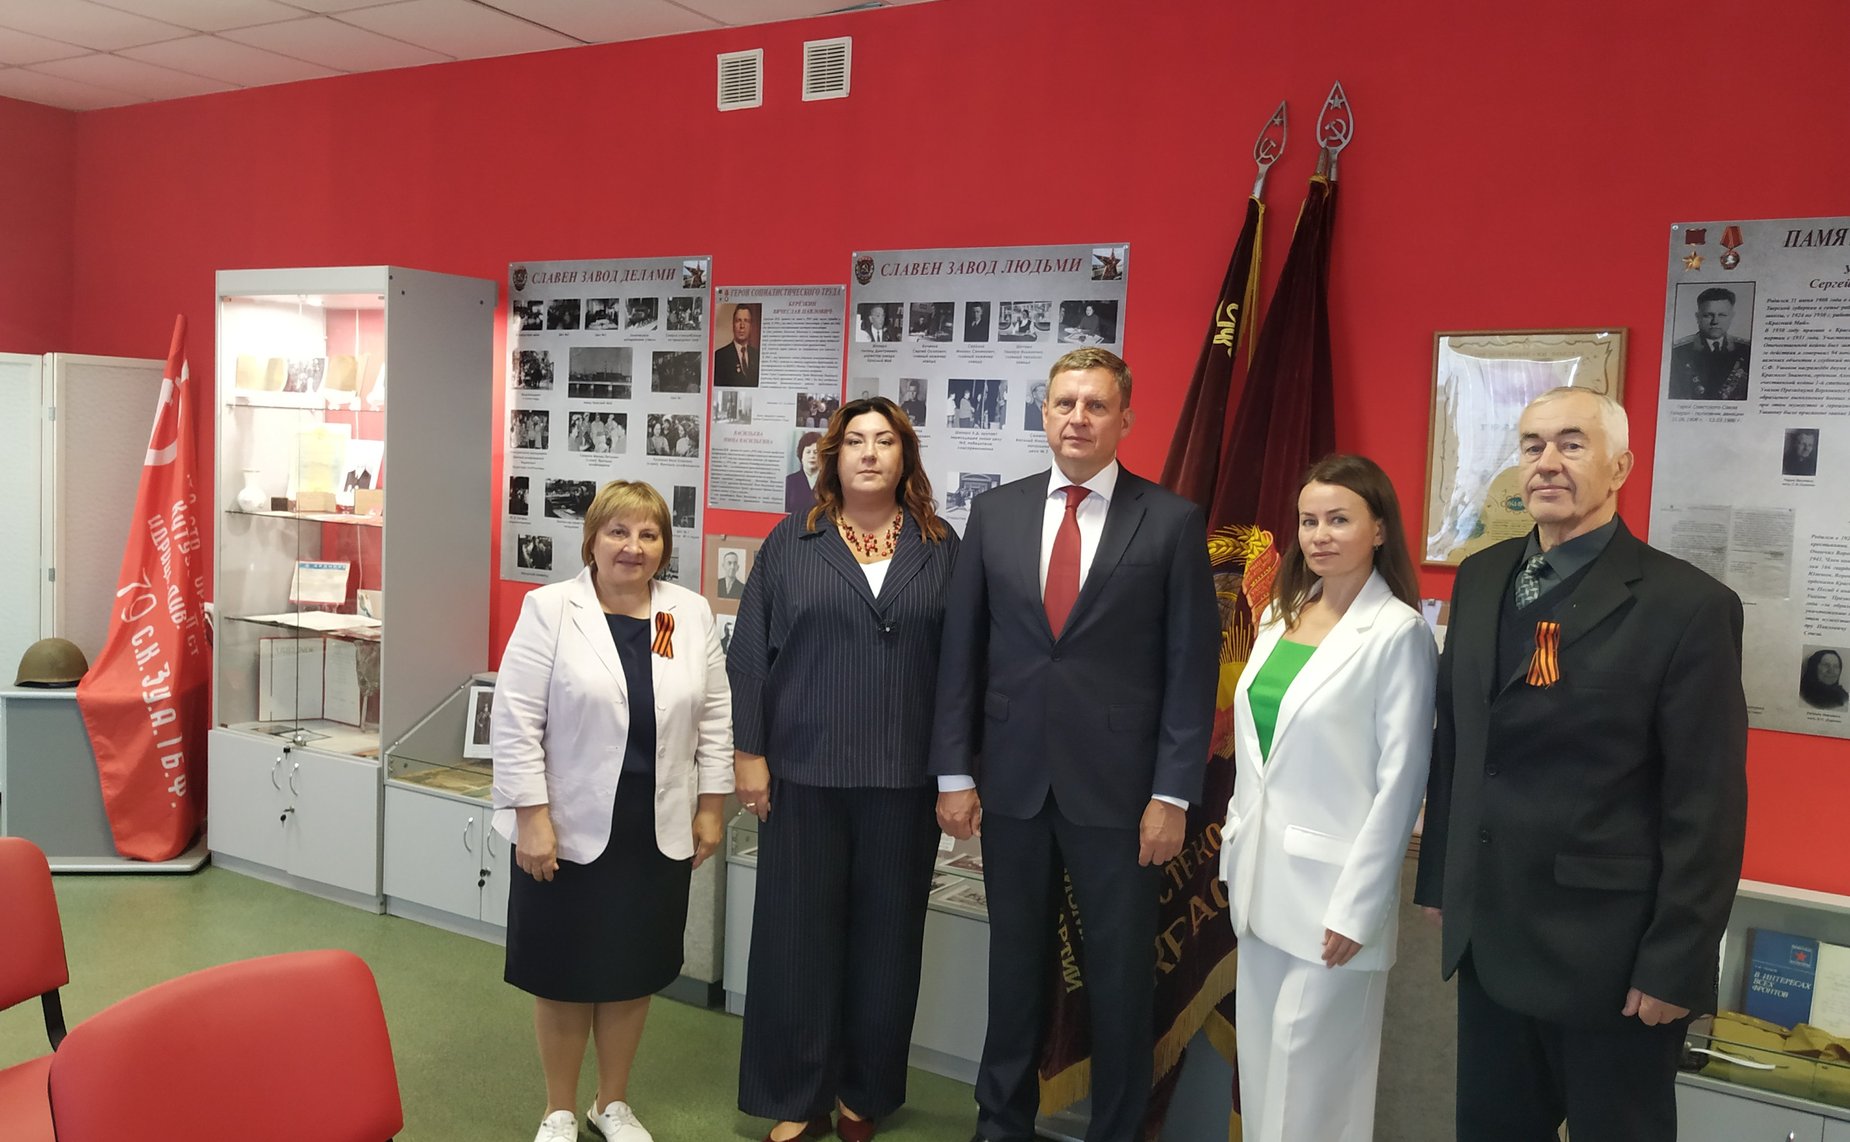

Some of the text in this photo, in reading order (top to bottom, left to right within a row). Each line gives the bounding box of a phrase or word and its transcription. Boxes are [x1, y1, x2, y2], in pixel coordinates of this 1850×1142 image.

[1784, 228, 1850, 248] ПАМЯ
[880, 258, 1082, 276] СЛАВЕН ЗАВОД ЛЮДЬМИ
[532, 268, 676, 284] СЛАВЕН ЗАВОД ДЕЛАМИ
[751, 288, 820, 297] СОЦИАЛИСТИЧЕСКОГО
[822, 288, 840, 296] ТРУДА
[116, 567, 157, 622] 79
[1752, 978, 1774, 988] ВСЕХ
[1762, 973, 1812, 990] ИНТЕРЕСАХ
[1752, 984, 1790, 999] ФРОНТОВ
